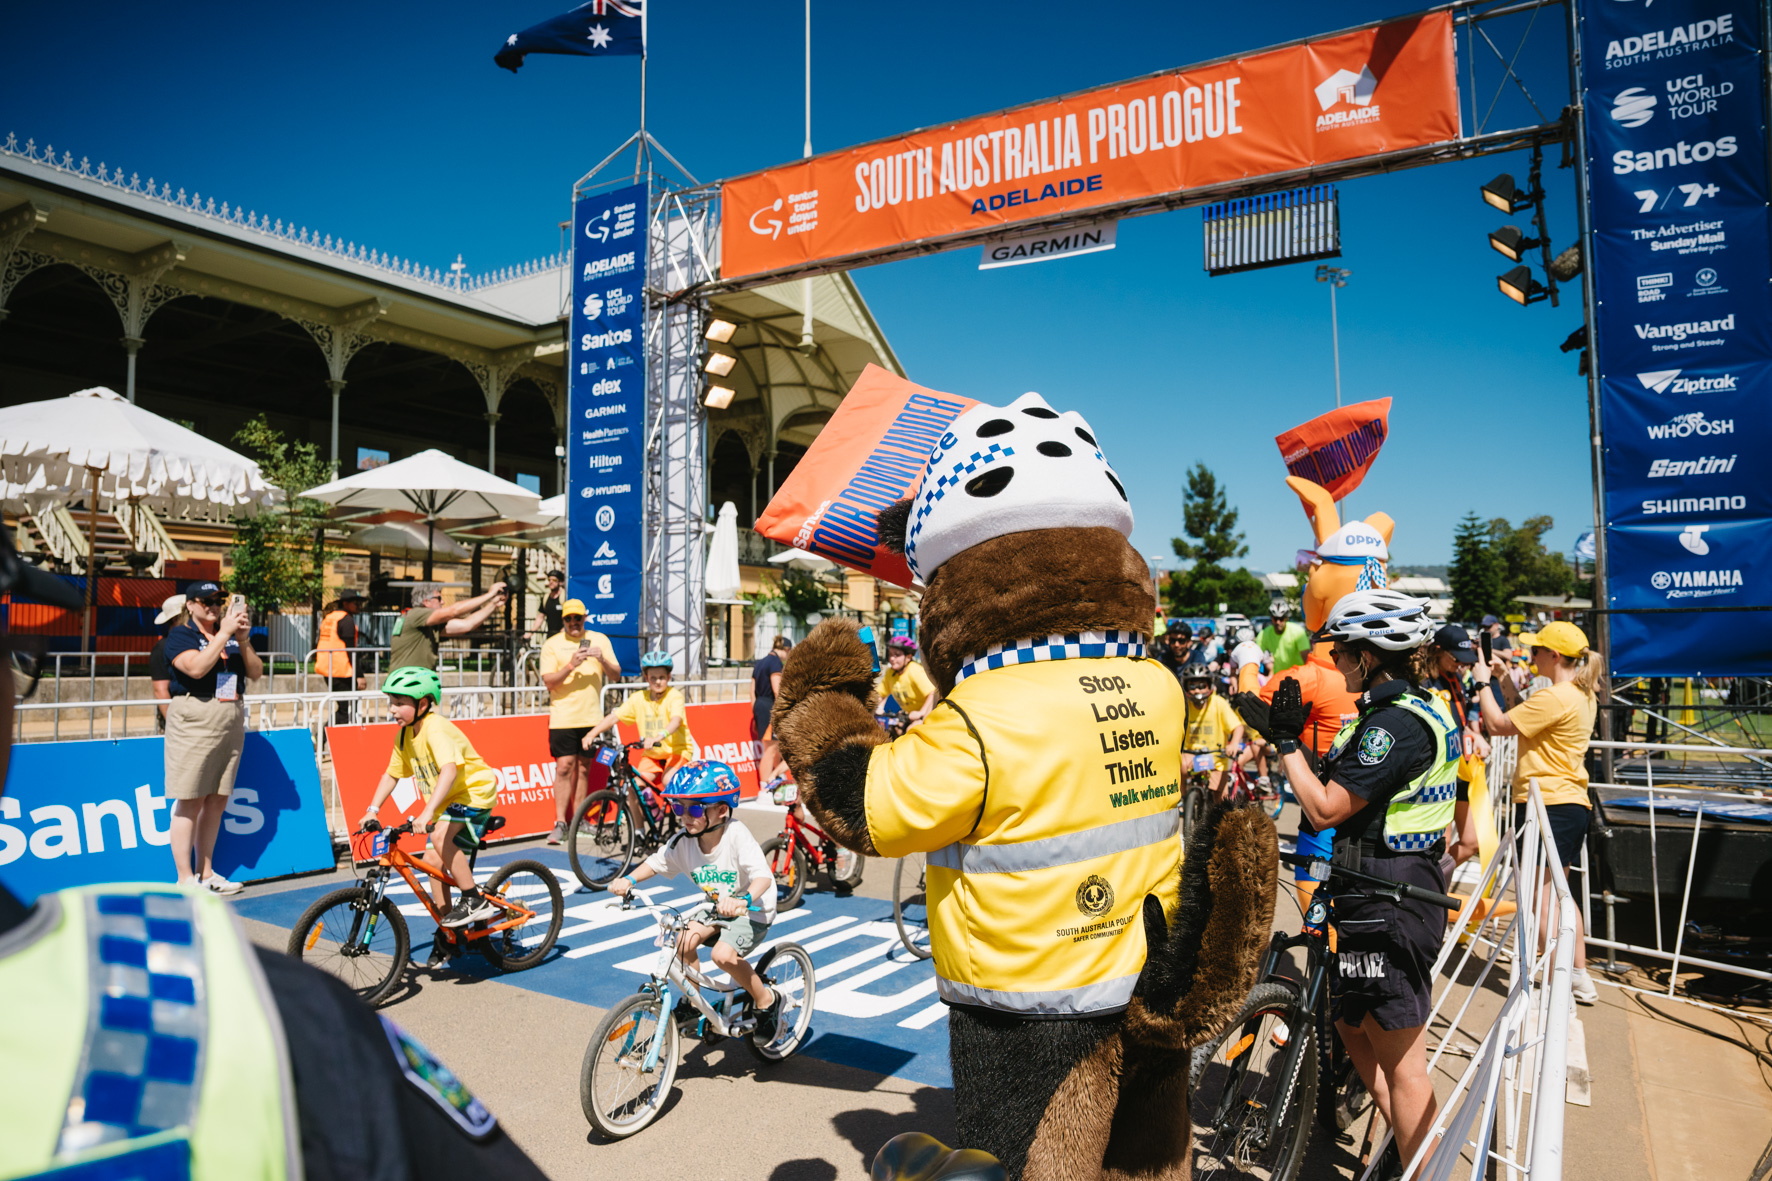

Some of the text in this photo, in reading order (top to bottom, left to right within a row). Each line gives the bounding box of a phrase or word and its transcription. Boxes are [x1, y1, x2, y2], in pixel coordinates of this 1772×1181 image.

[1605, 13, 1734, 60] ADELAIDE
[1605, 34, 1734, 70] SOUTH AUSTRALIA
[1666, 74, 1703, 93] UCI
[1667, 82, 1734, 106] WORLD
[1316, 105, 1380, 127] ADELAIDE
[1668, 100, 1718, 120] TOUR
[1316, 117, 1380, 133] SOUTH AUSTRALIA
[855, 77, 1242, 213] SOUTH AUSTRALIA PROLOGUE
[1612, 136, 1738, 175] Santos
[788, 190, 818, 204] Santos
[970, 175, 1103, 215] ADELAIDE
[1634, 189, 1660, 214] 7
[618, 211, 635, 221] tour
[794, 200, 818, 213] tour
[614, 219, 634, 230] down
[789, 210, 818, 224] down
[613, 227, 634, 239] under
[787, 221, 818, 236] under
[1631, 220, 1724, 240] The Advertiser
[991, 229, 1104, 261] GARMIN
[1650, 231, 1725, 252] Sunday Mail
[583, 251, 635, 276] ADELAIDE
[606, 288, 623, 299] UCI
[606, 294, 633, 308] WORLD
[1638, 288, 1661, 297] ROAD
[606, 304, 626, 316] TOUR
[1634, 314, 1735, 340] Vanguard
[582, 328, 632, 351] Santos
[1652, 338, 1725, 351] Strong and Steady
[592, 378, 622, 397] efex
[1671, 373, 1737, 395] Ziptrak
[585, 403, 626, 419] GARMIN
[1647, 418, 1734, 440] WHOOSH
[589, 454, 622, 468] Hilton
[1313, 437, 1355, 484] DOWN
[1647, 455, 1737, 478] Santini
[595, 483, 631, 496] HYUNDAI
[809, 393, 965, 570] TOUR DOWN UNDER
[1642, 495, 1746, 514] SHIMANO
[792, 499, 830, 549] Santos
[1346, 535, 1381, 547] OPPY
[1672, 569, 1743, 587] YAMAHA
[1078, 675, 1132, 694] Stop.
[1090, 698, 1146, 723] Look.
[1099, 729, 1160, 754] Listen.
[703, 741, 764, 764] ADELAID
[492, 761, 557, 792] DELAI
[1104, 757, 1157, 785] Think.
[1109, 778, 1179, 808] Walk when saf
[690, 871, 737, 885] AUSAGE
[1056, 926, 1079, 937] SOUTH
[1080, 919, 1115, 934] AUSTRALIA
[1073, 928, 1124, 943] SAFER COMMUNITIES
[1338, 952, 1385, 978] POLICE
